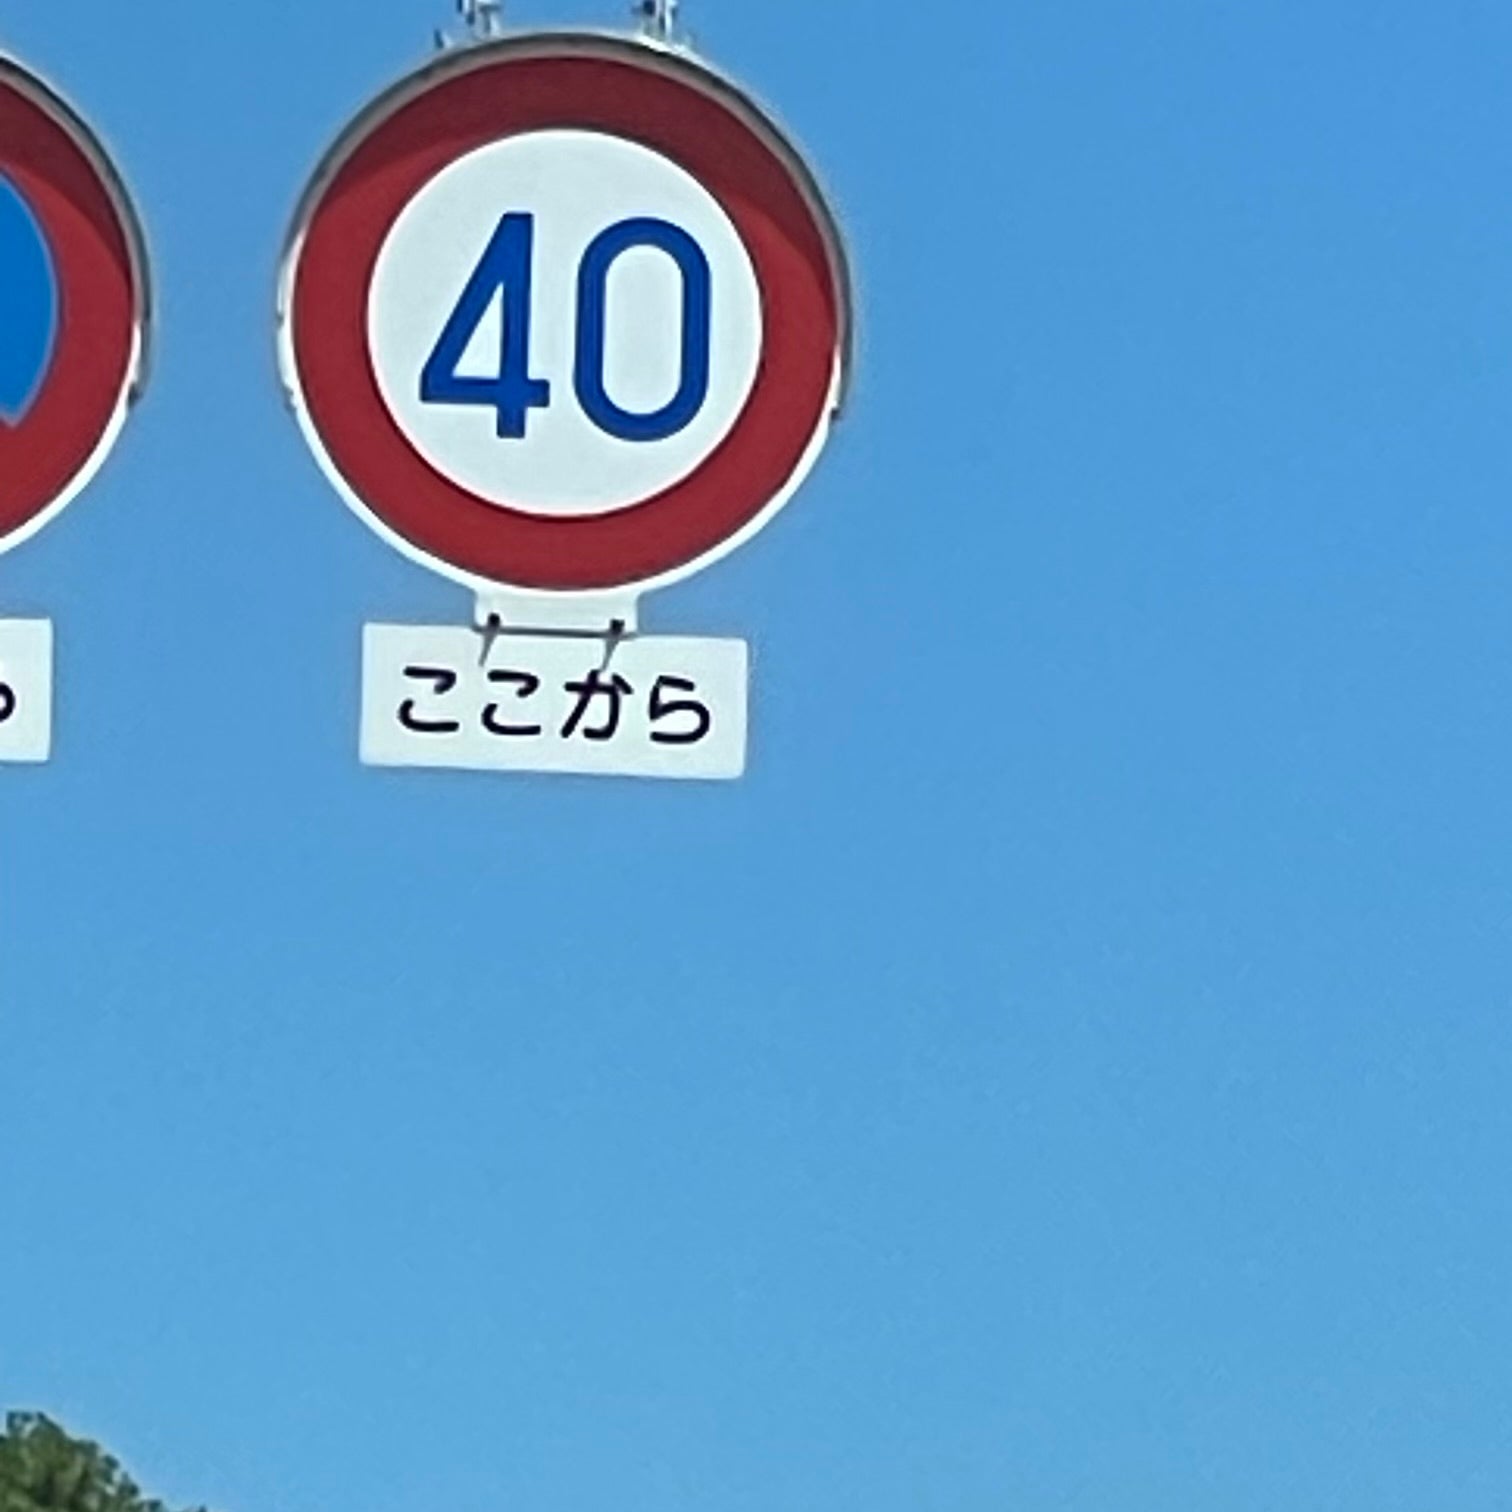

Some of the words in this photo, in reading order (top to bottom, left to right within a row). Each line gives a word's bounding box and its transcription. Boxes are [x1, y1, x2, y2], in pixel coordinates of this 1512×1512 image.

[419, 211, 712, 442] 40
[397, 666, 711, 744] ここから
